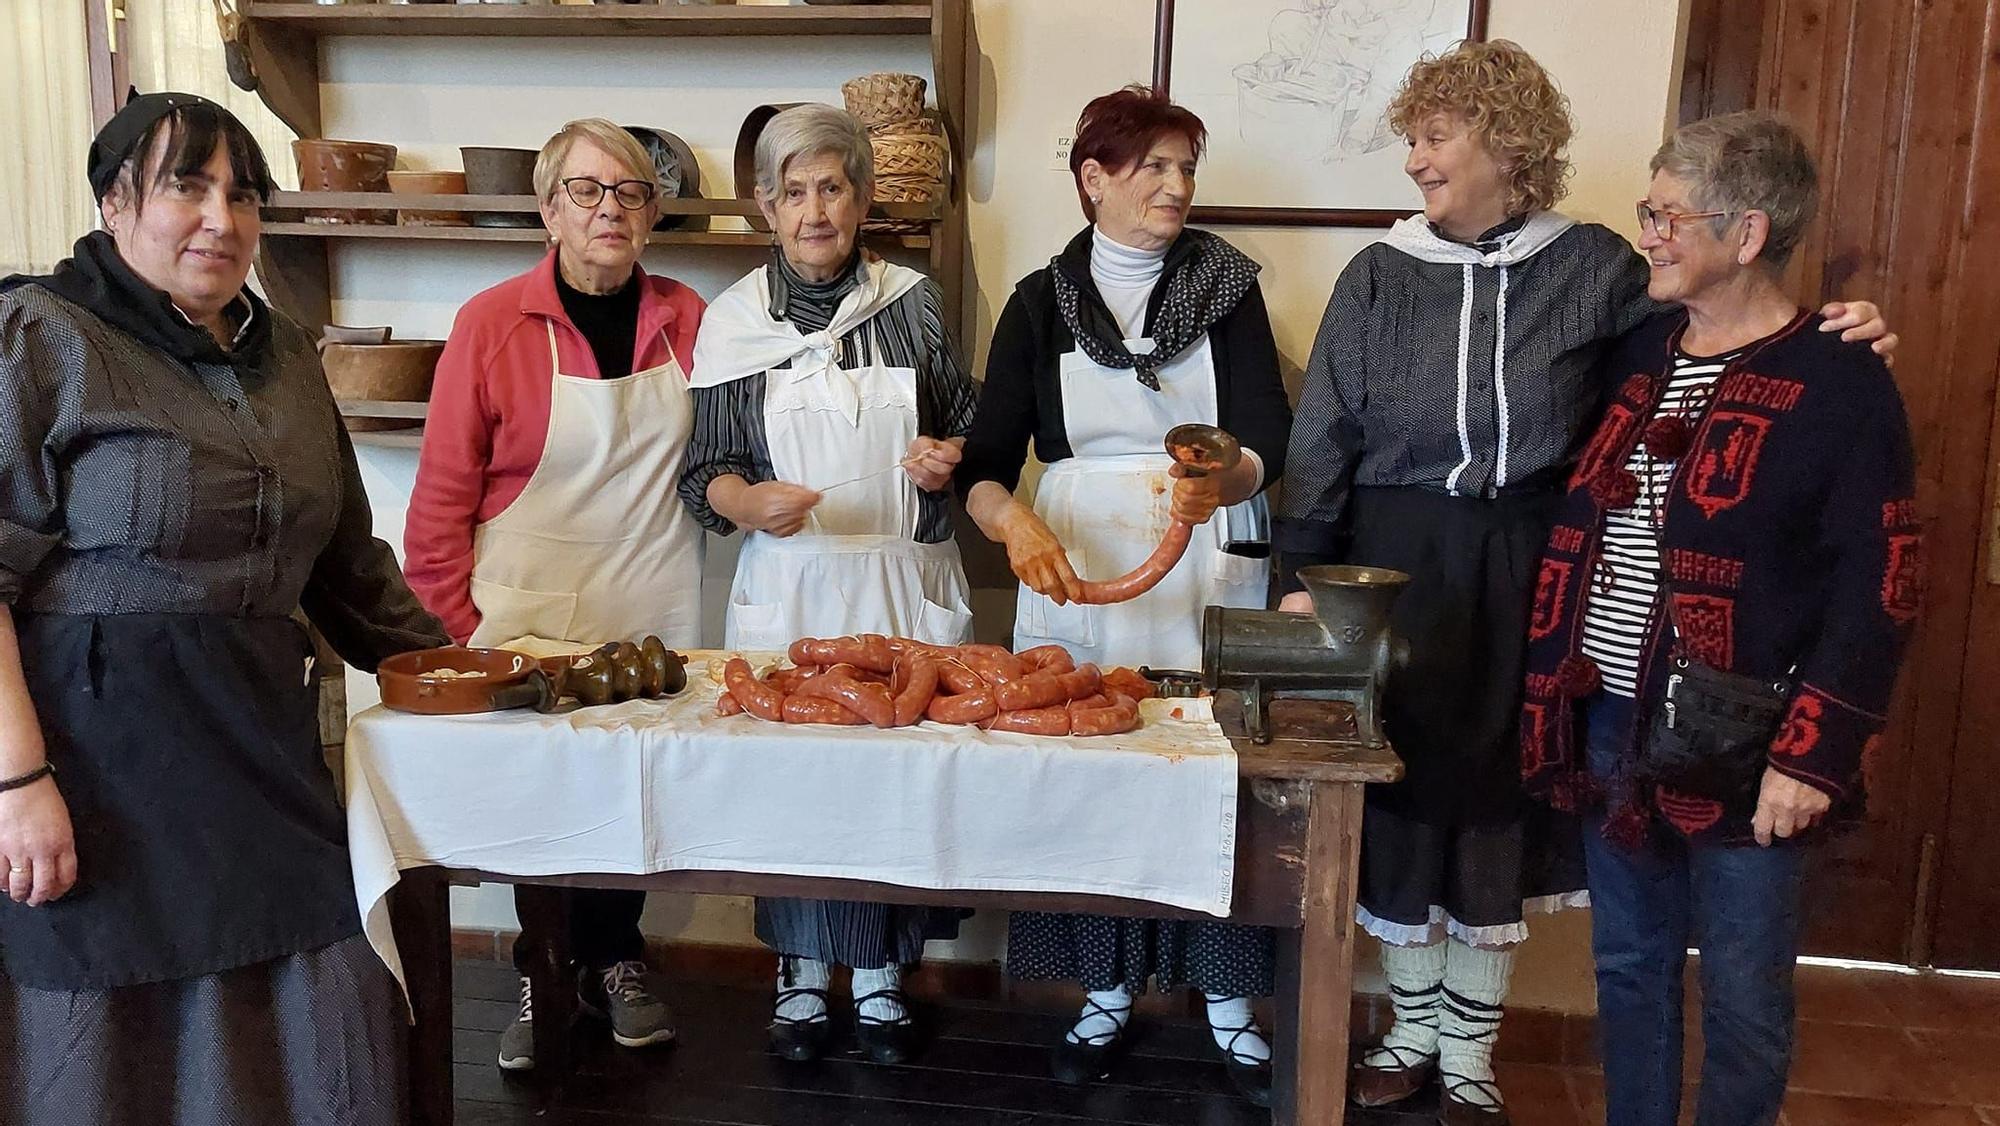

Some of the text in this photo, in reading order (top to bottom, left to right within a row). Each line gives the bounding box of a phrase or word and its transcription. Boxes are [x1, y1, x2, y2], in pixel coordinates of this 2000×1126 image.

[1058, 137, 1070, 146] EZ
[1055, 151, 1068, 159] NO
[1220, 868, 1231, 905] MUSEO
